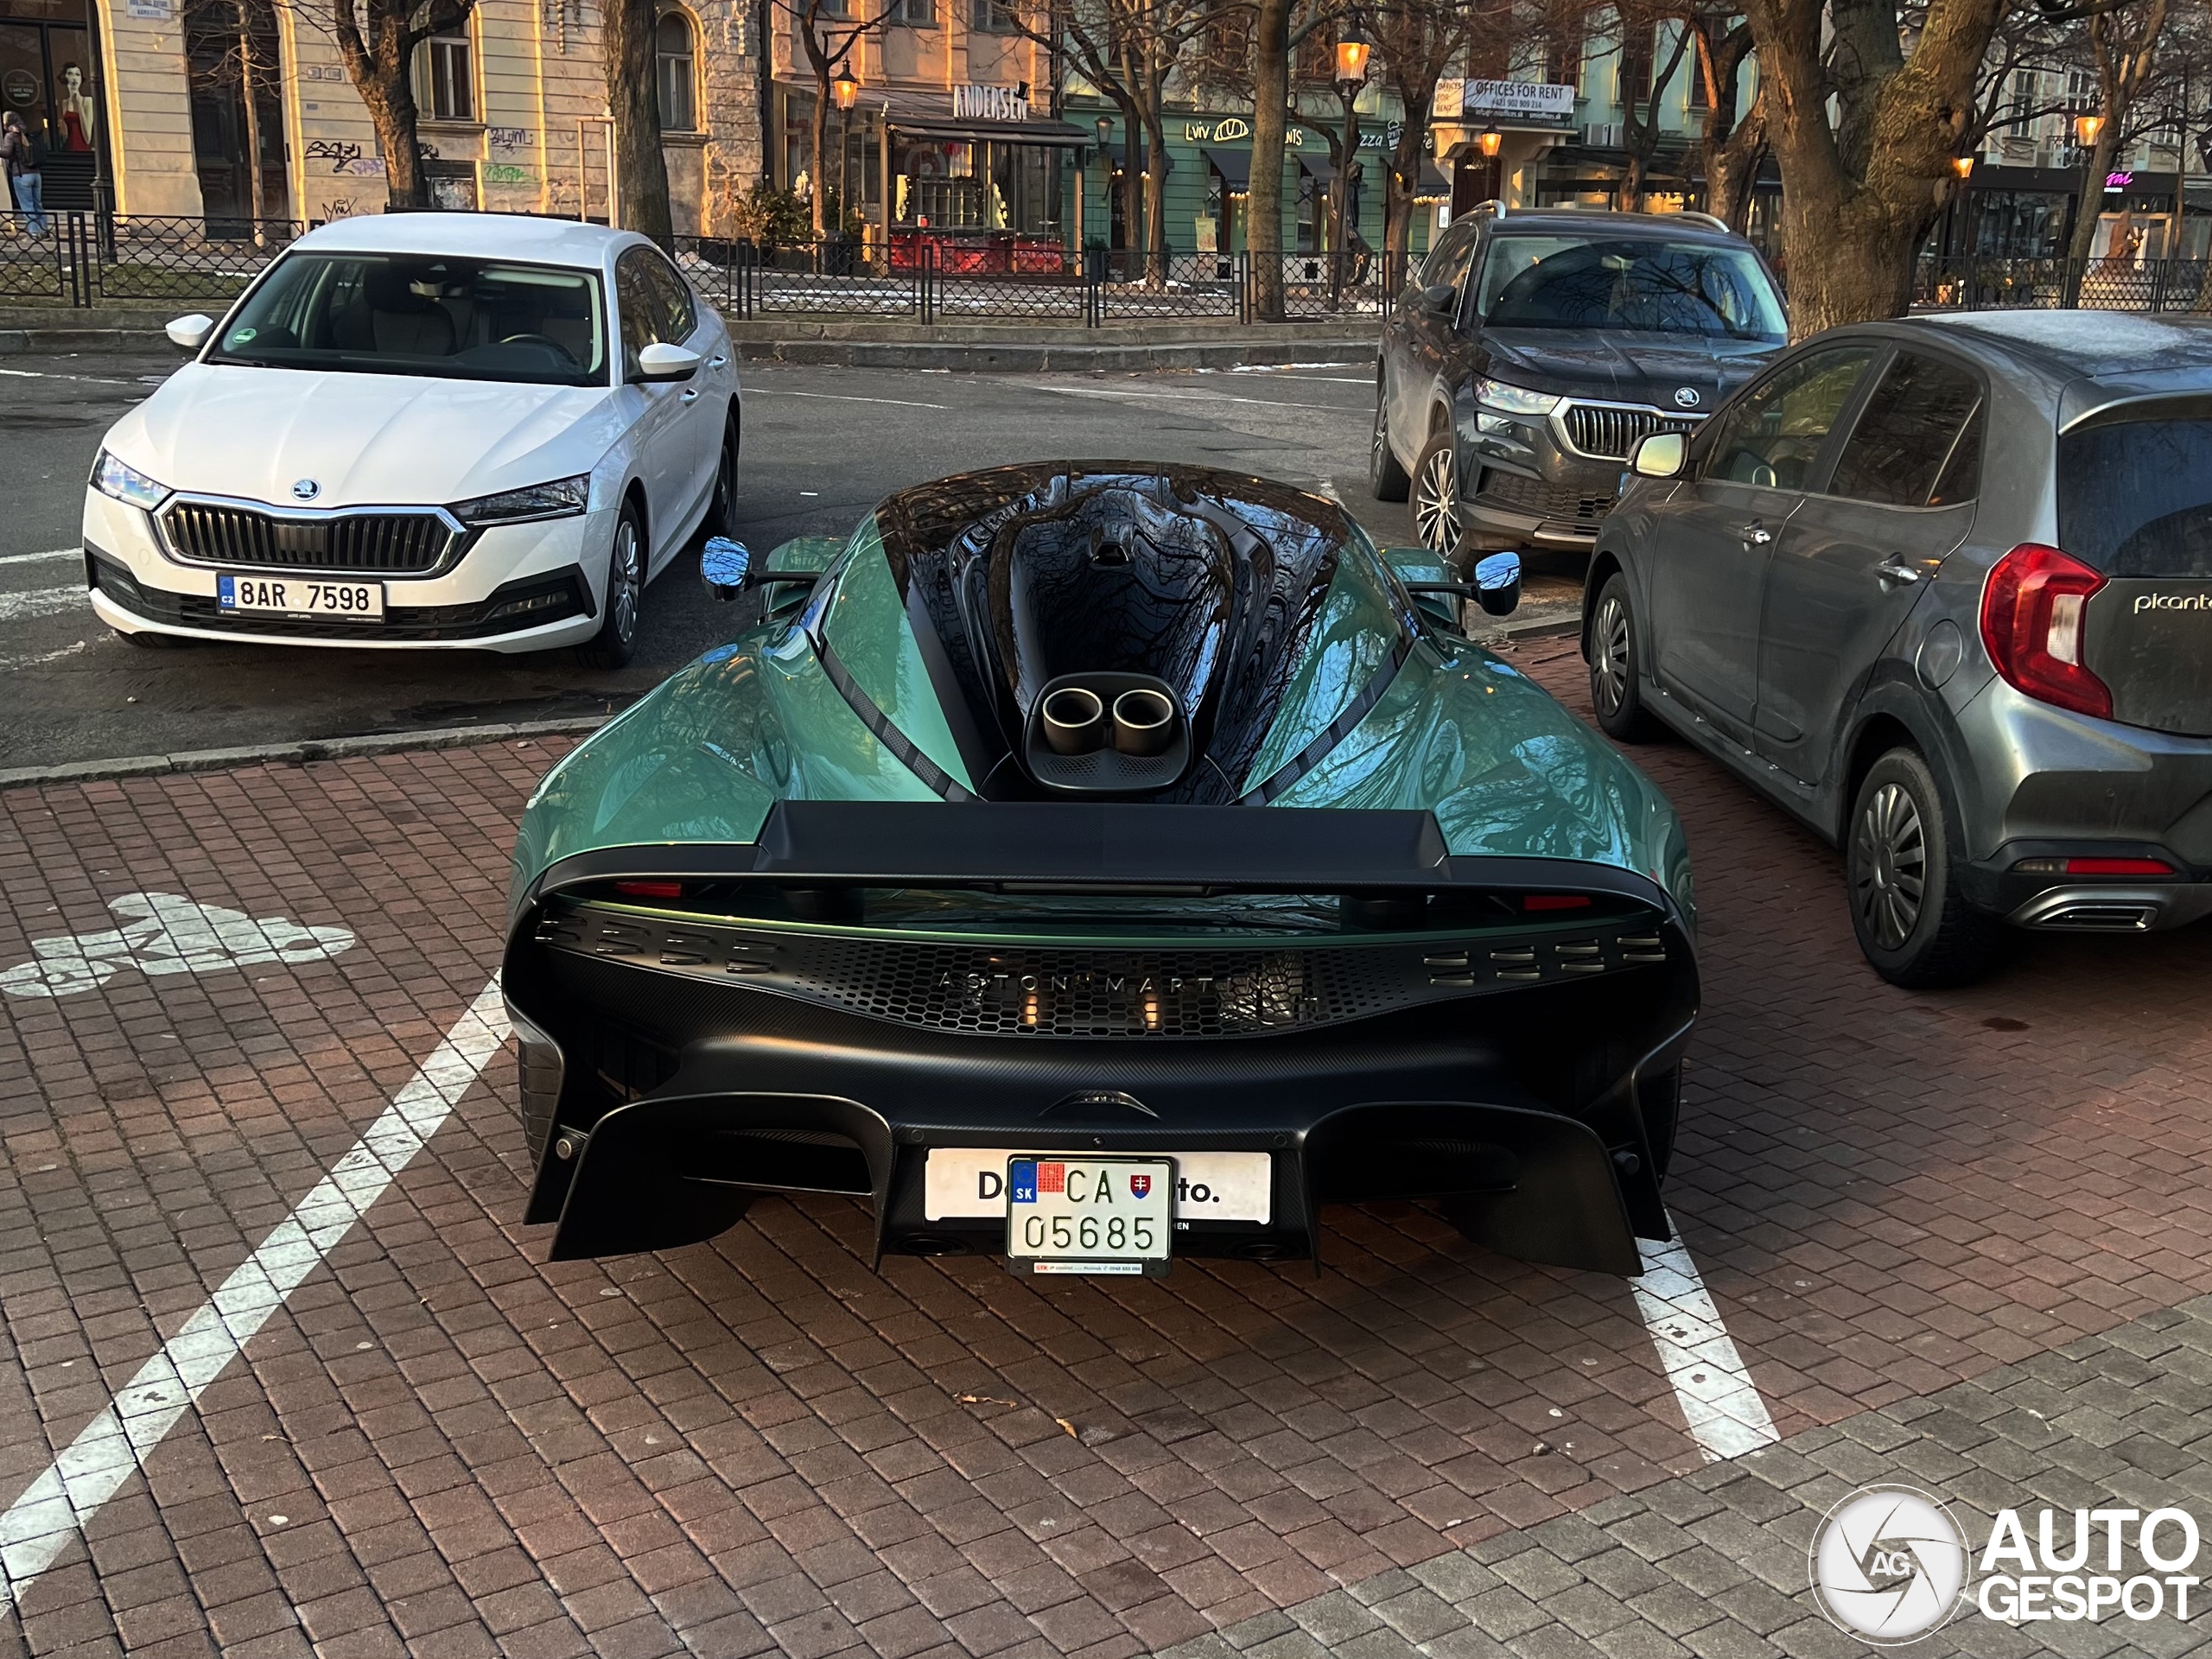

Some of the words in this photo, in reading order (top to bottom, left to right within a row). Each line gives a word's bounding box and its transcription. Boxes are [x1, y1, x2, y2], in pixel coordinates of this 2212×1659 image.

[953, 85, 1027, 120] ANDERSEN
[1476, 82, 1514, 96] OFFICES
[1517, 86, 1536, 98] FOR
[1539, 87, 1563, 99] RENT
[221, 594, 234, 604] CZ
[240, 582, 286, 607] 8AR
[307, 584, 370, 611] 7598
[938, 972, 1069, 991] ASTON
[1105, 975, 1263, 993] MARTIN
[1016, 1188, 1033, 1199] SK
[1067, 1170, 1113, 1204] CA
[1025, 1215, 1154, 1250] 05685
